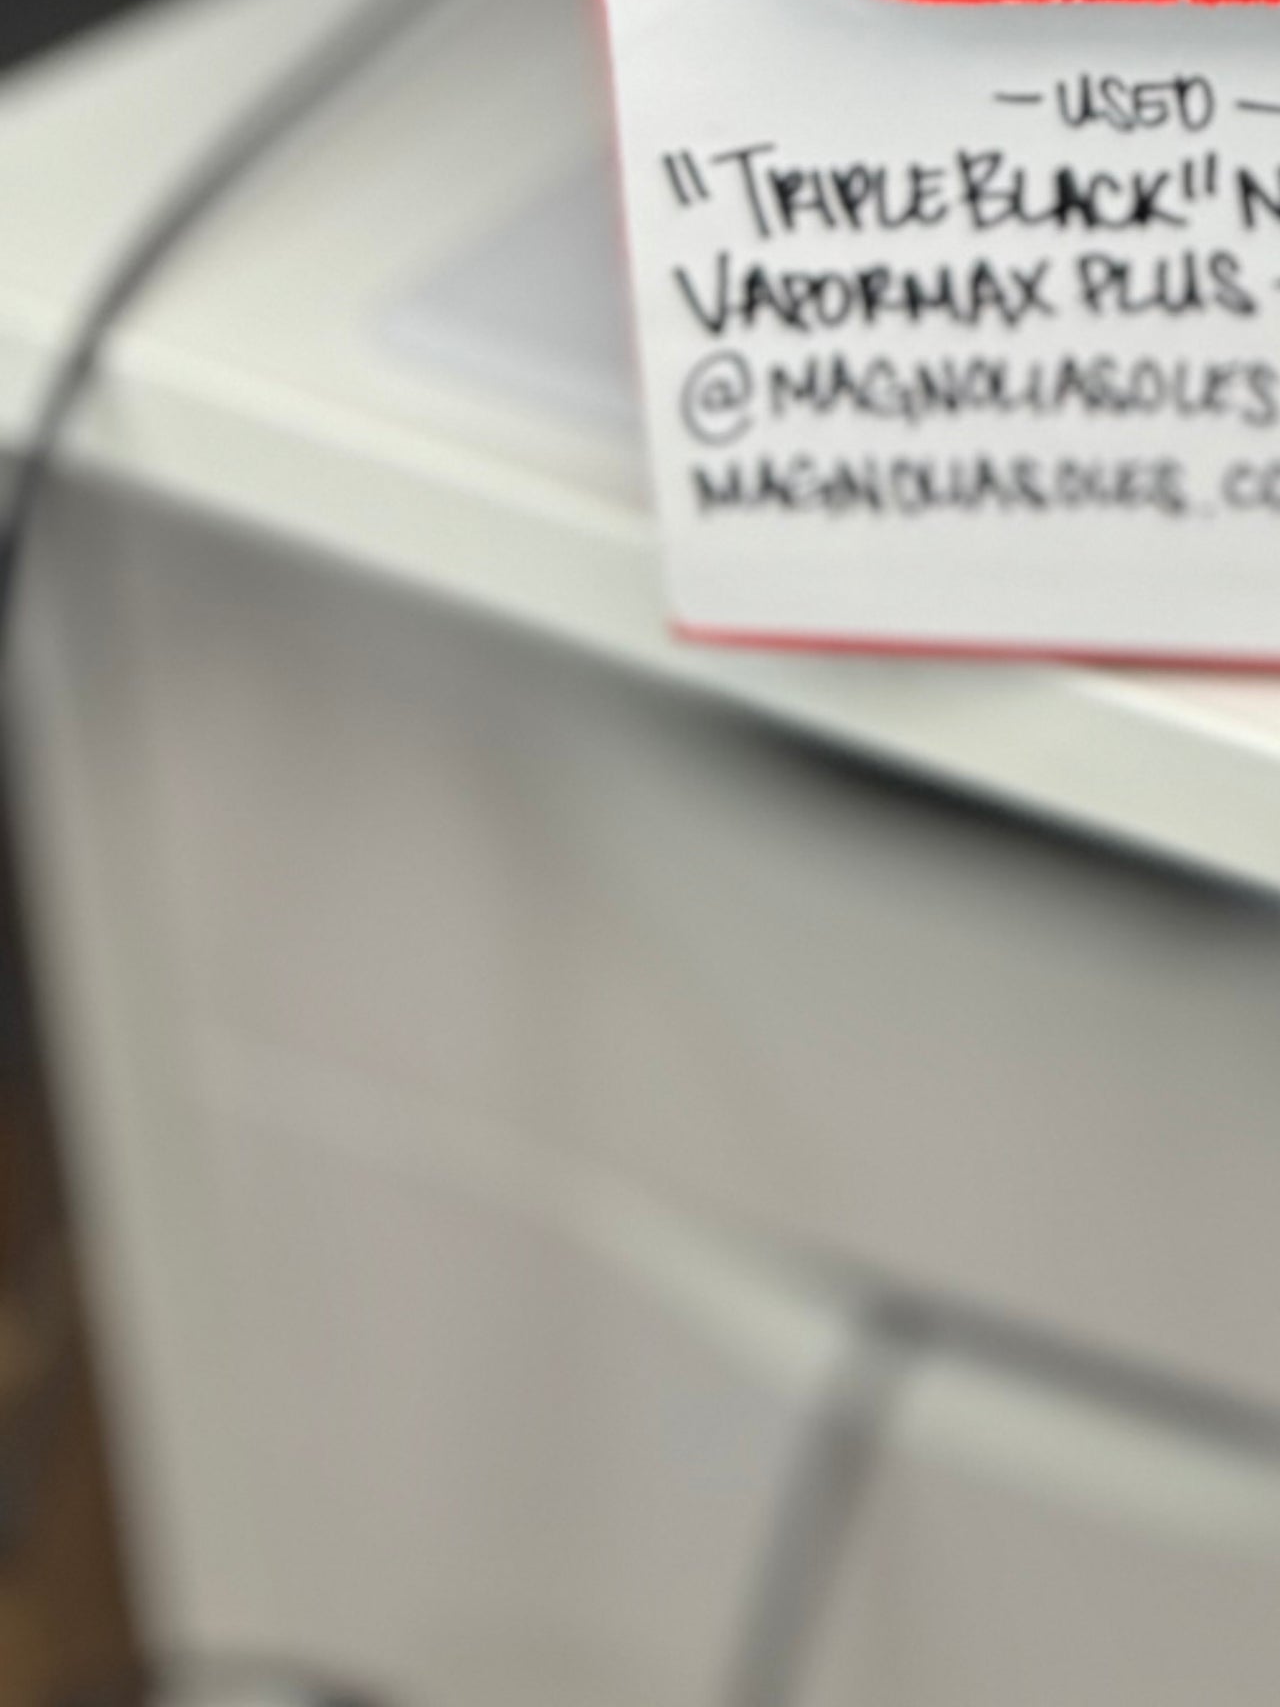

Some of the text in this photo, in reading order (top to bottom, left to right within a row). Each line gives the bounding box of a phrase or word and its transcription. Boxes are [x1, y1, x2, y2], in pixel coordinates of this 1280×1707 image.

[1055, 75, 1217, 133] USED
[673, 250, 1056, 339] VAPORMAX
[1075, 249, 1259, 318] PLUS
